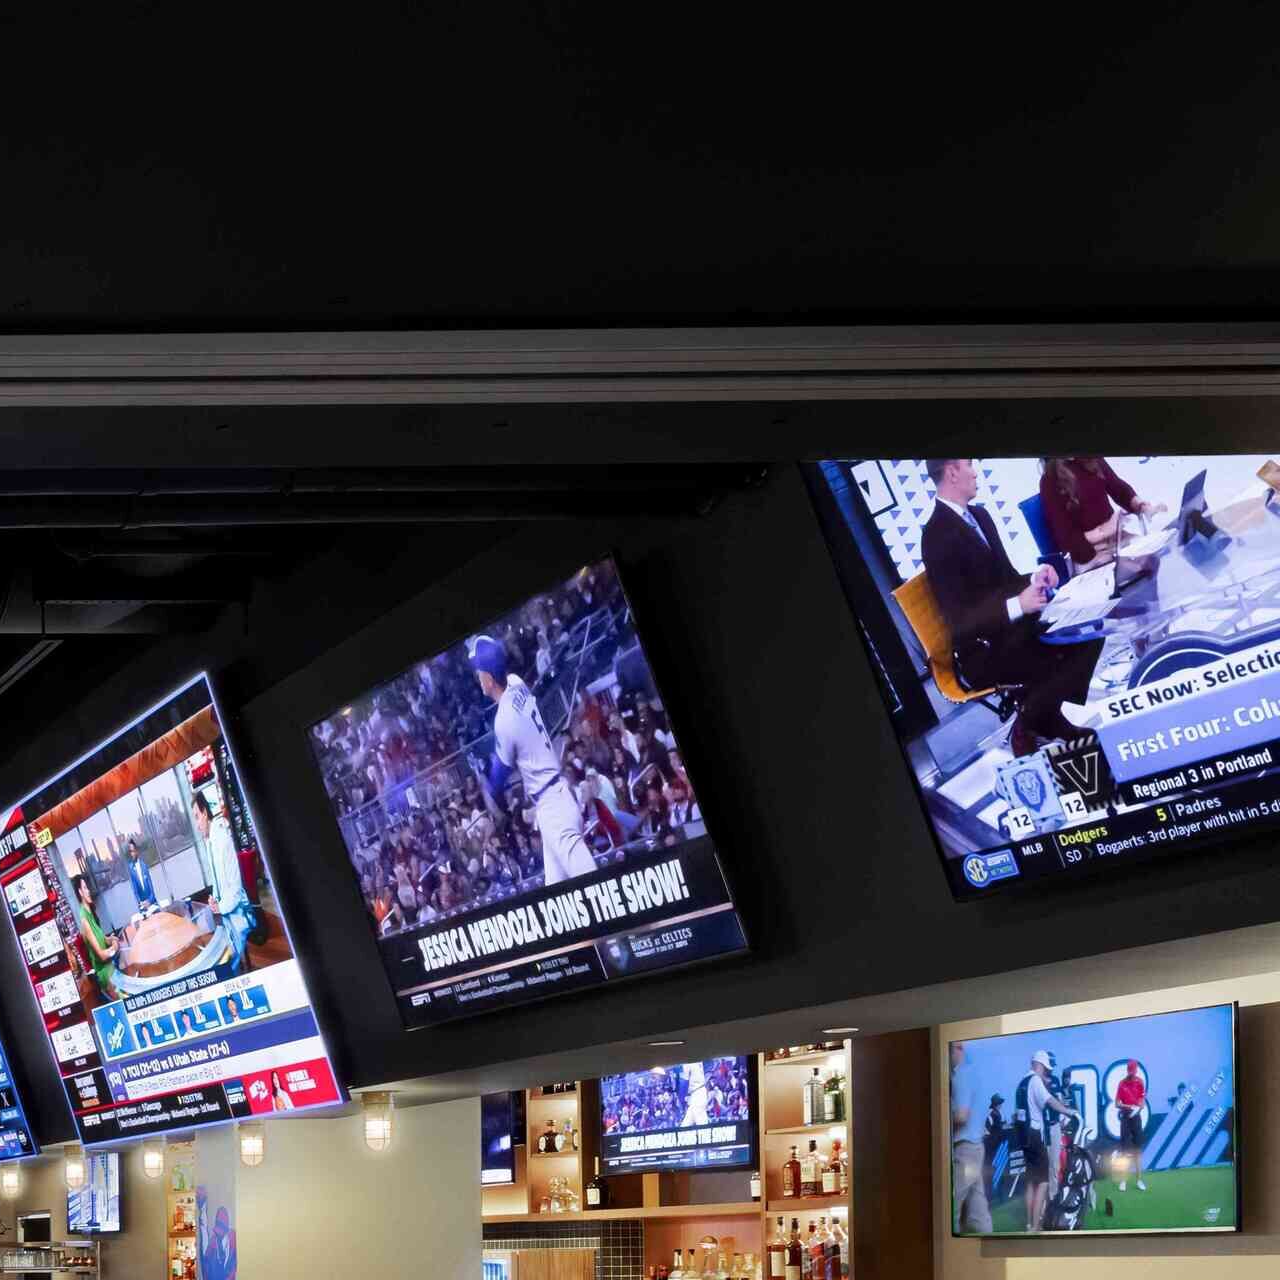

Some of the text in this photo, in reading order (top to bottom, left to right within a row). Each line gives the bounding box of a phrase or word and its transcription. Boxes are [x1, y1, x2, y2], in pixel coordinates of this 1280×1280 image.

[1109, 695, 1144, 718] SEC
[1147, 680, 1200, 706] Now:
[1117, 732, 1168, 762] First
[1170, 716, 1231, 746] Four:
[1057, 752, 1098, 796] V
[1133, 748, 1272, 798] Regional 3 in Portland
[1013, 814, 1031, 828] 12
[1059, 797, 1222, 847] Dodgers 5 Padres
[1065, 799, 1084, 814] 12
[1022, 843, 1043, 856] MLB
[1066, 849, 1082, 863] SD
[1097, 834, 1147, 855] Bogaerts:
[1148, 827, 1167, 843] 3rd
[1169, 821, 1202, 840] player
[1203, 813, 1229, 829] with
[1231, 809, 1246, 823] hit
[1248, 807, 1259, 818] in
[1260, 802, 1270, 815] 5
[418, 859, 689, 972] JESSICA MENDOZA JOINS THE SHOW!
[662, 928, 692, 944] CELTICS
[128, 1064, 141, 1077] TCU
[160, 1060, 168, 1069] vs
[174, 1052, 190, 1065] Utah
[190, 1048, 209, 1062] State
[207, 1041, 230, 1060] (27-6)
[1068, 1059, 1149, 1141] 18
